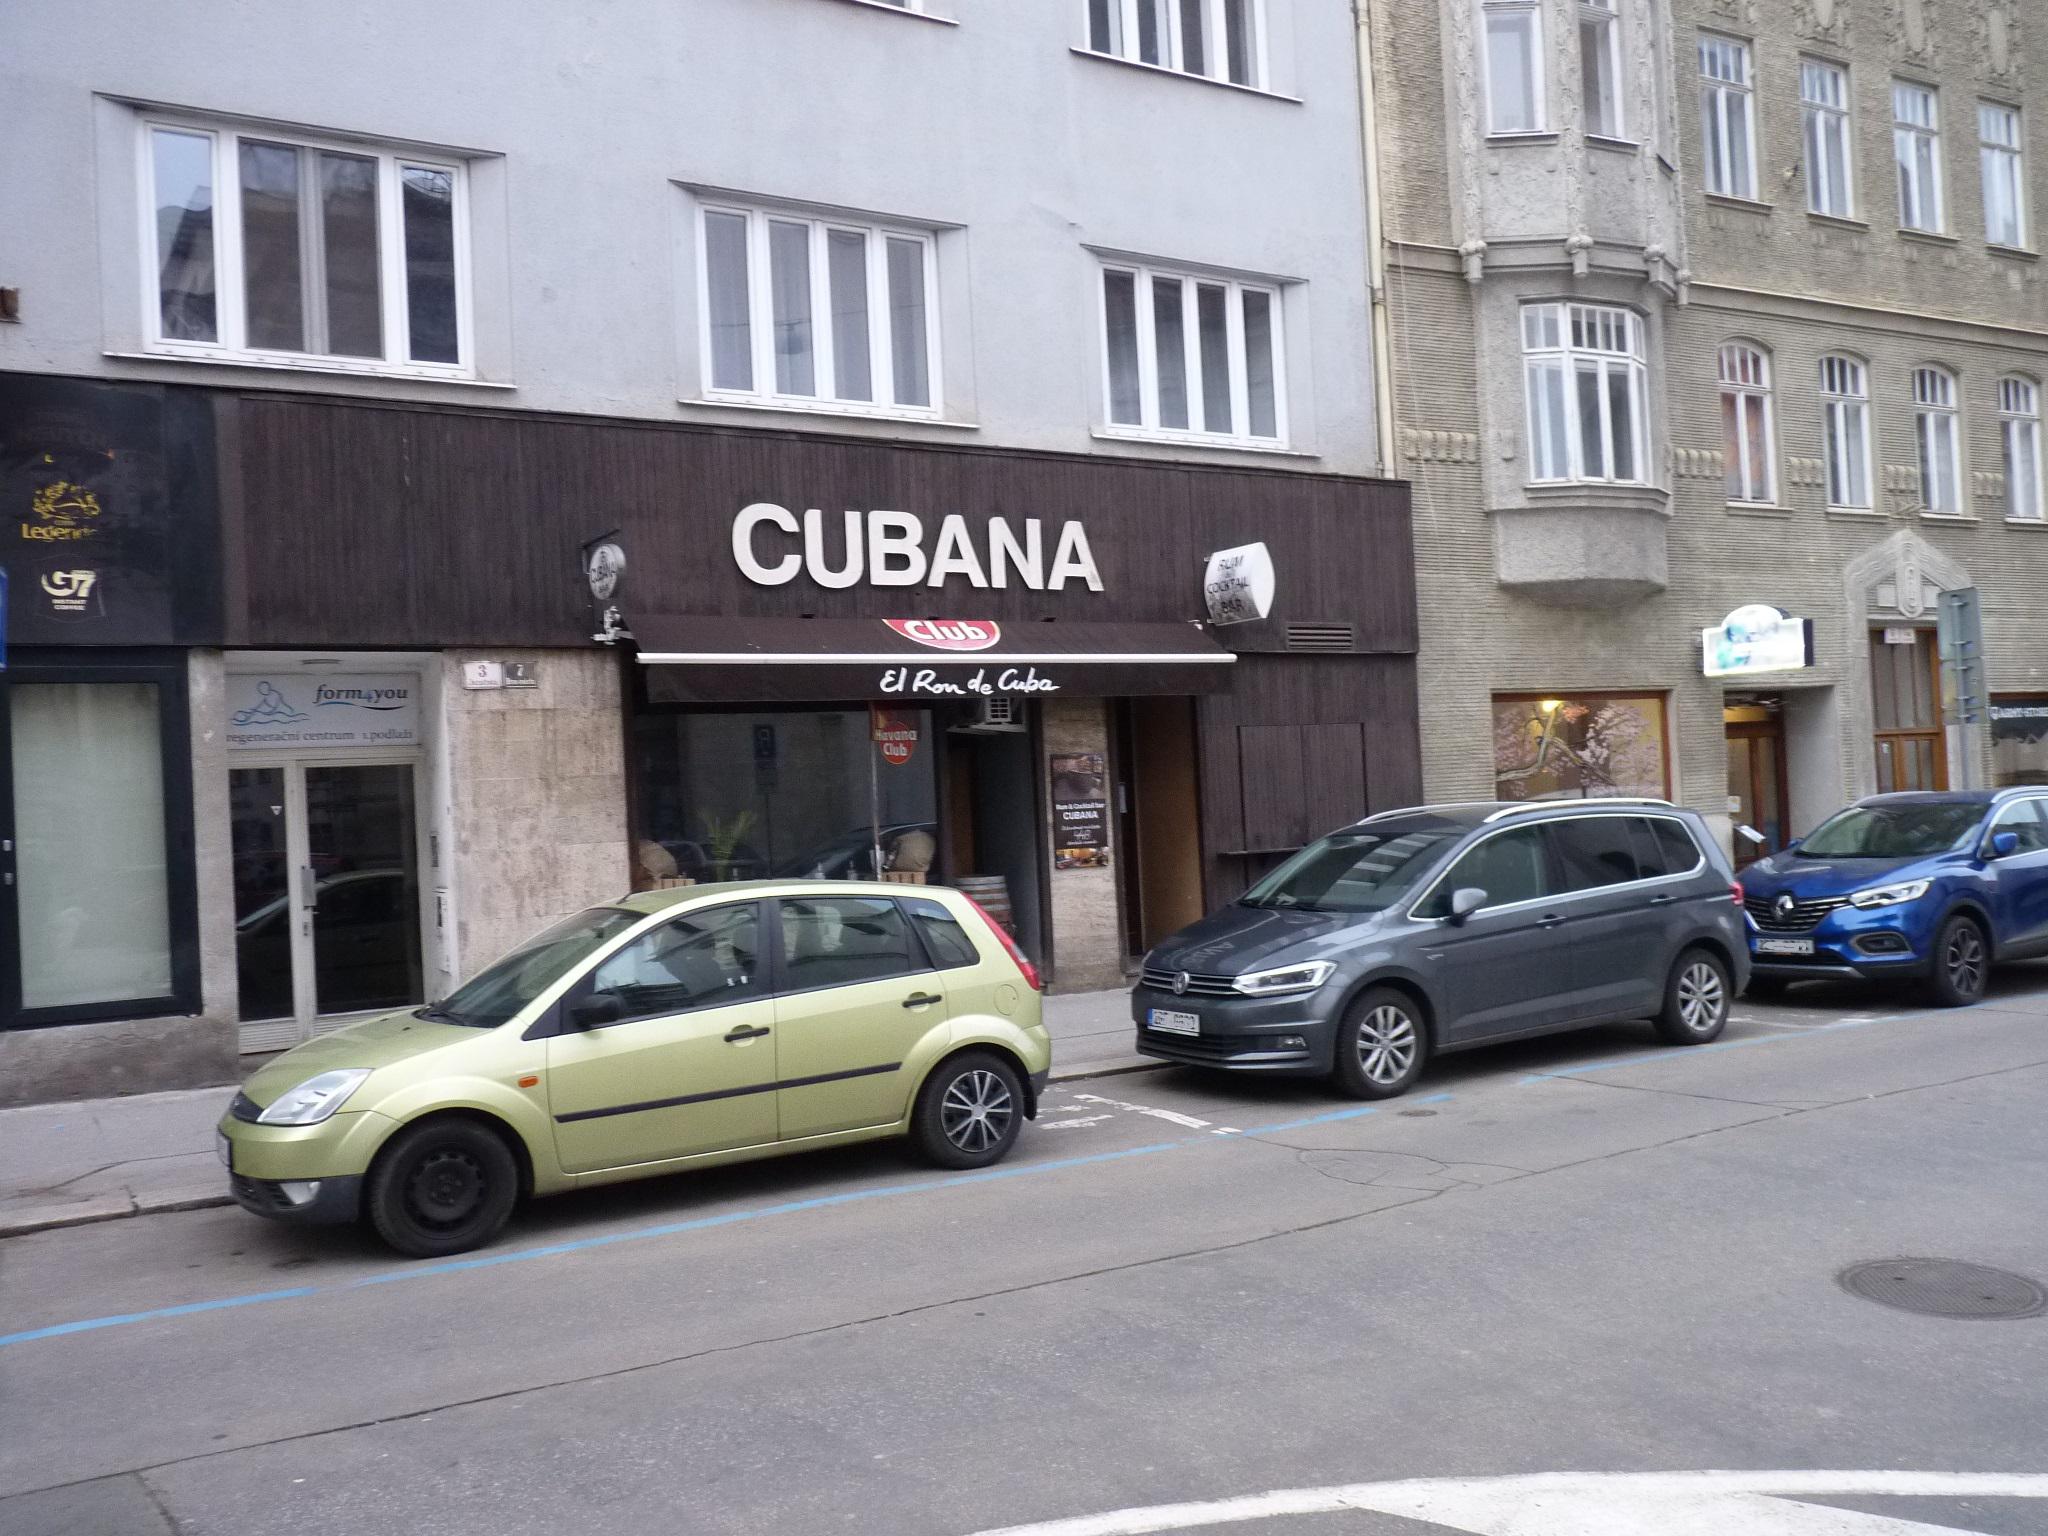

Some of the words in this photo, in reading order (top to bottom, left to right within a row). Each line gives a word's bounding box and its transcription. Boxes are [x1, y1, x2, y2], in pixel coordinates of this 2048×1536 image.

[731, 502, 1104, 593] CUBANA
[903, 620, 989, 641] Club
[478, 664, 488, 678] 3
[879, 666, 908, 693] El
[912, 669, 967, 695] Ron
[967, 668, 995, 695] de
[997, 666, 1061, 694] Cuba
[302, 730, 355, 741] centrum
[883, 742, 908, 756] Club
[1062, 811, 1100, 820] CUBANA
